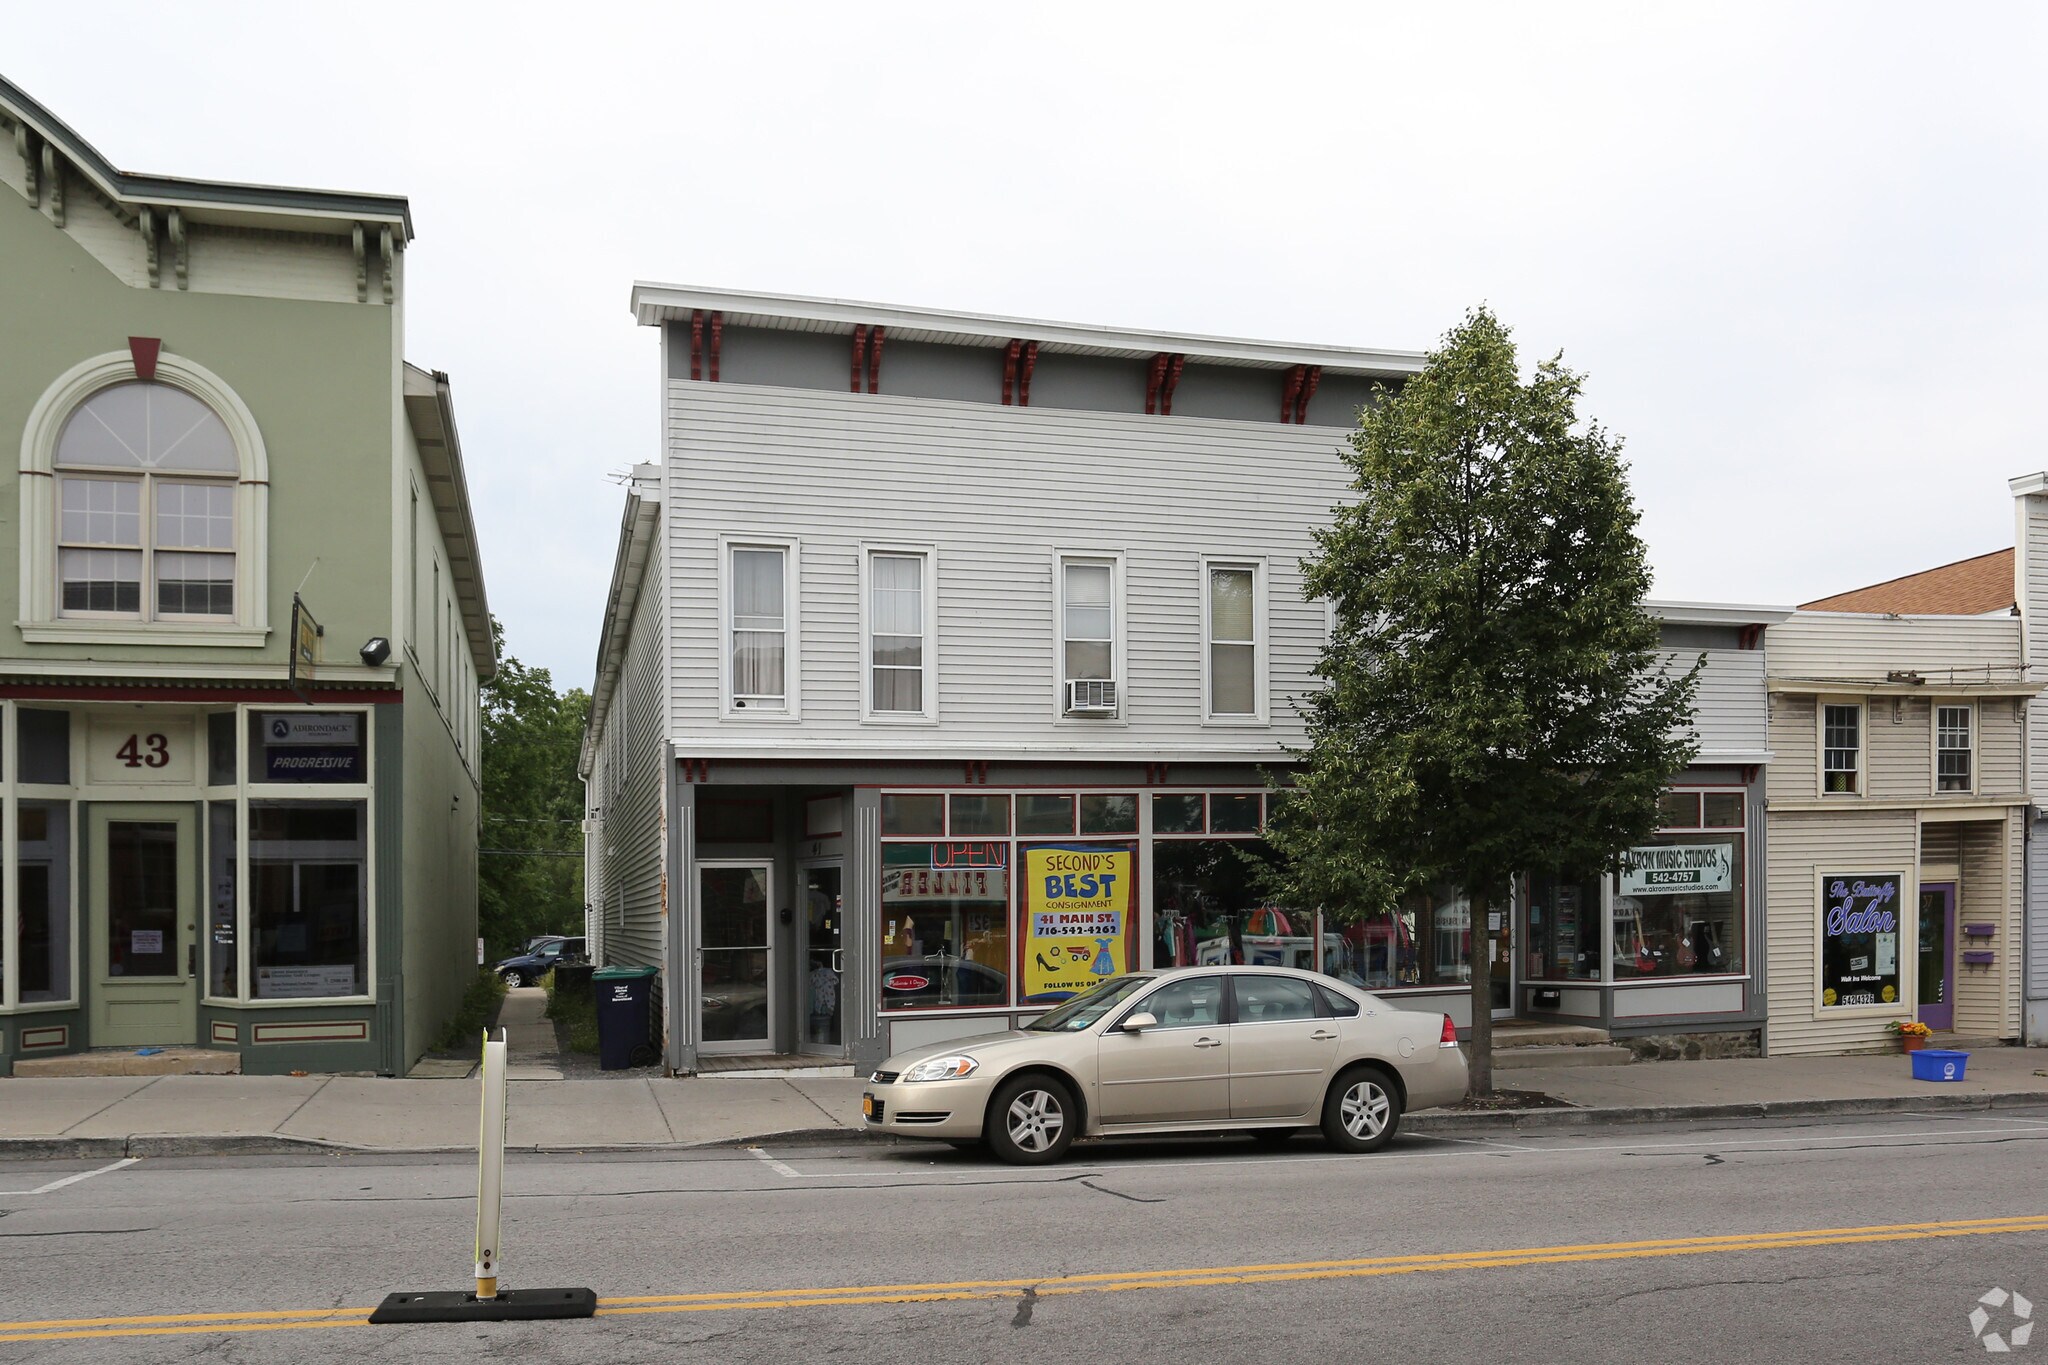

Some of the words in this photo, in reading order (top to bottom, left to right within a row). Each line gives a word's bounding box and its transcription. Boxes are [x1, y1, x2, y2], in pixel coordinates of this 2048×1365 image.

[293, 724, 348, 732] ADIRONDACK
[115, 733, 170, 768] 43
[273, 757, 354, 768] PROGRESSIVE
[933, 843, 1002, 868] OPEN
[1656, 849, 1683, 869] MUSIC
[1684, 848, 1717, 868] STUDIOS
[1045, 854, 1115, 871] SECOND'S
[1652, 872, 1694, 883] 542-4757
[1044, 873, 1116, 899] BEST
[1632, 884, 1719, 893] www.akronmusicstudios.com
[1829, 881, 1849, 898] The
[1851, 880, 1895, 903] Butterfly
[1045, 900, 1113, 909] CONSIGNMENT
[1040, 915, 1054, 924] 41
[1059, 914, 1094, 924] MAIN
[1097, 913, 1115, 923] ST.
[1827, 895, 1897, 937] Salon
[1038, 925, 1116, 935] 716-542-4262
[1044, 981, 1073, 989] FOLLOW
